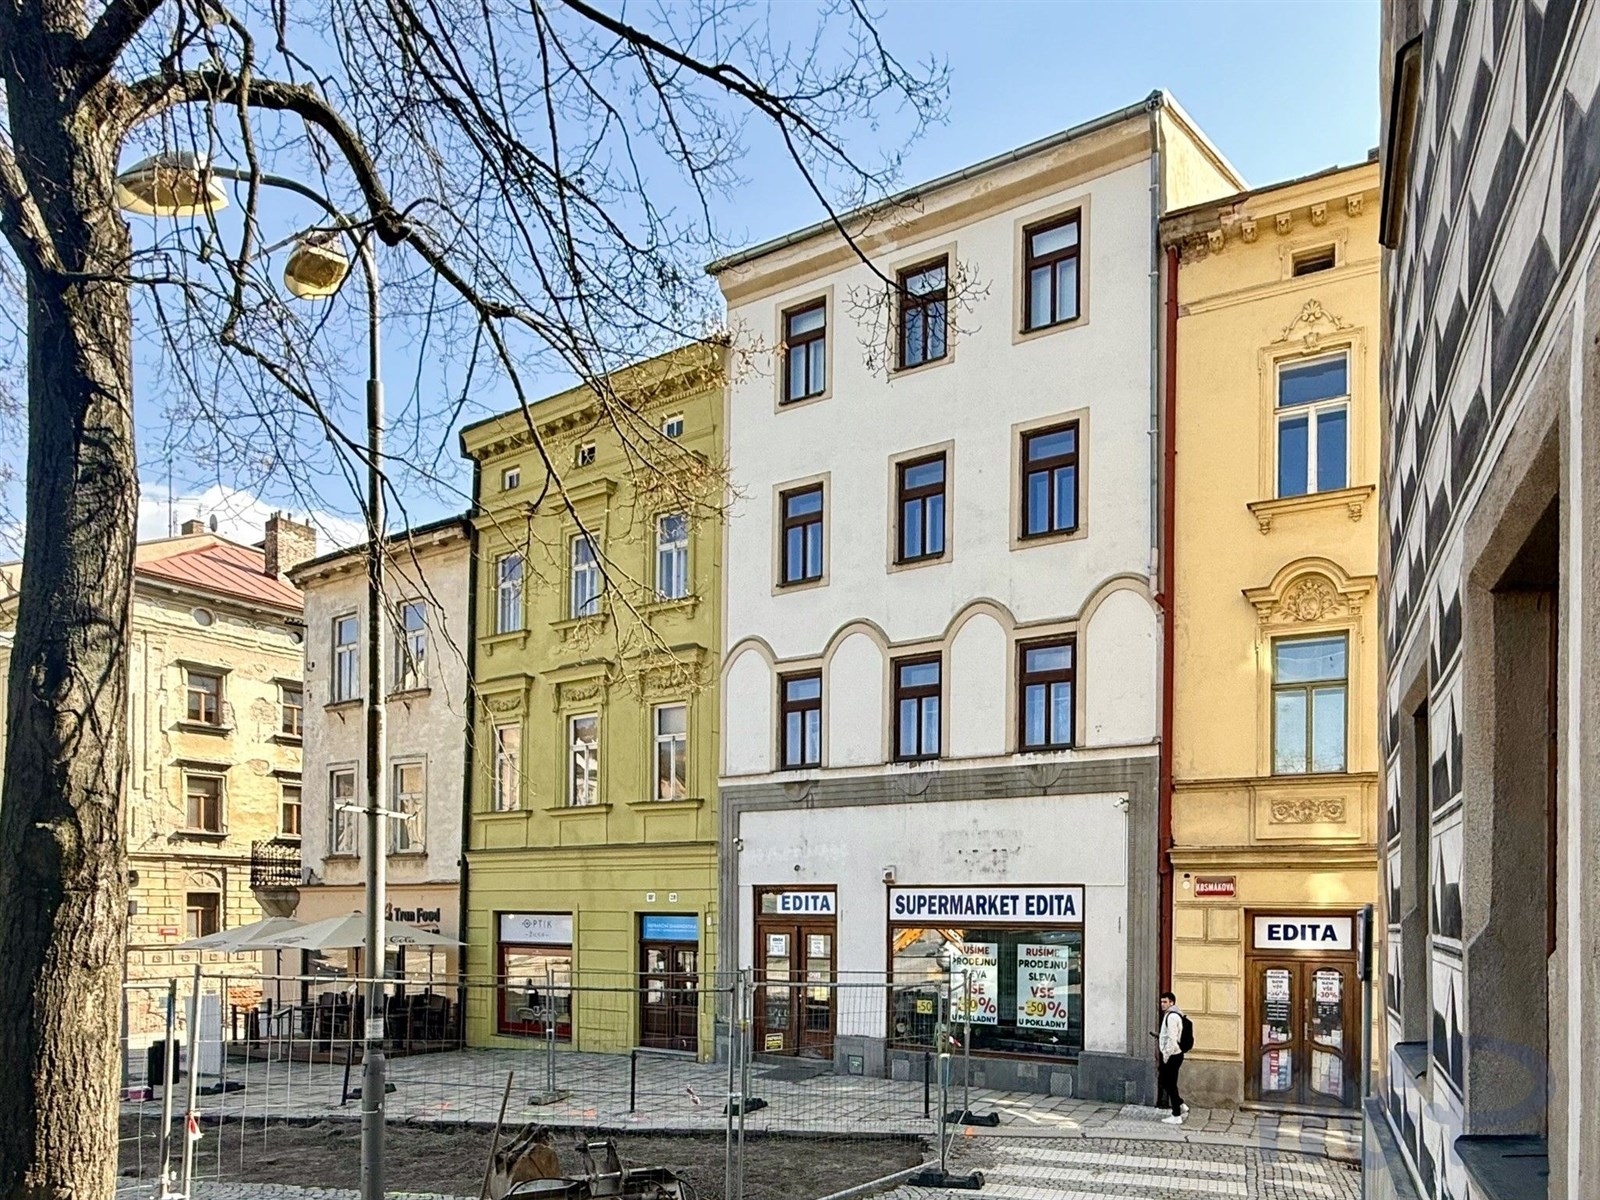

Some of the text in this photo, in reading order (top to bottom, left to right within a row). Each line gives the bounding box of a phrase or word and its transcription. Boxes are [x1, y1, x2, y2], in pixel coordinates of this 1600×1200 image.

[781, 894, 831, 912] EDITA
[895, 894, 1077, 916] SUPERMARKET EDITA
[416, 907, 441, 924] Food
[1267, 923, 1337, 941] EDITA
[1025, 946, 1060, 957] RUŠÍME
[1018, 959, 1068, 970] PRODEJNU
[1028, 972, 1057, 982] SLEVA
[1030, 984, 1055, 999] VŠE
[918, 1001, 932, 1012] -50
[1025, 1018, 1067, 1028] POKLADNY
